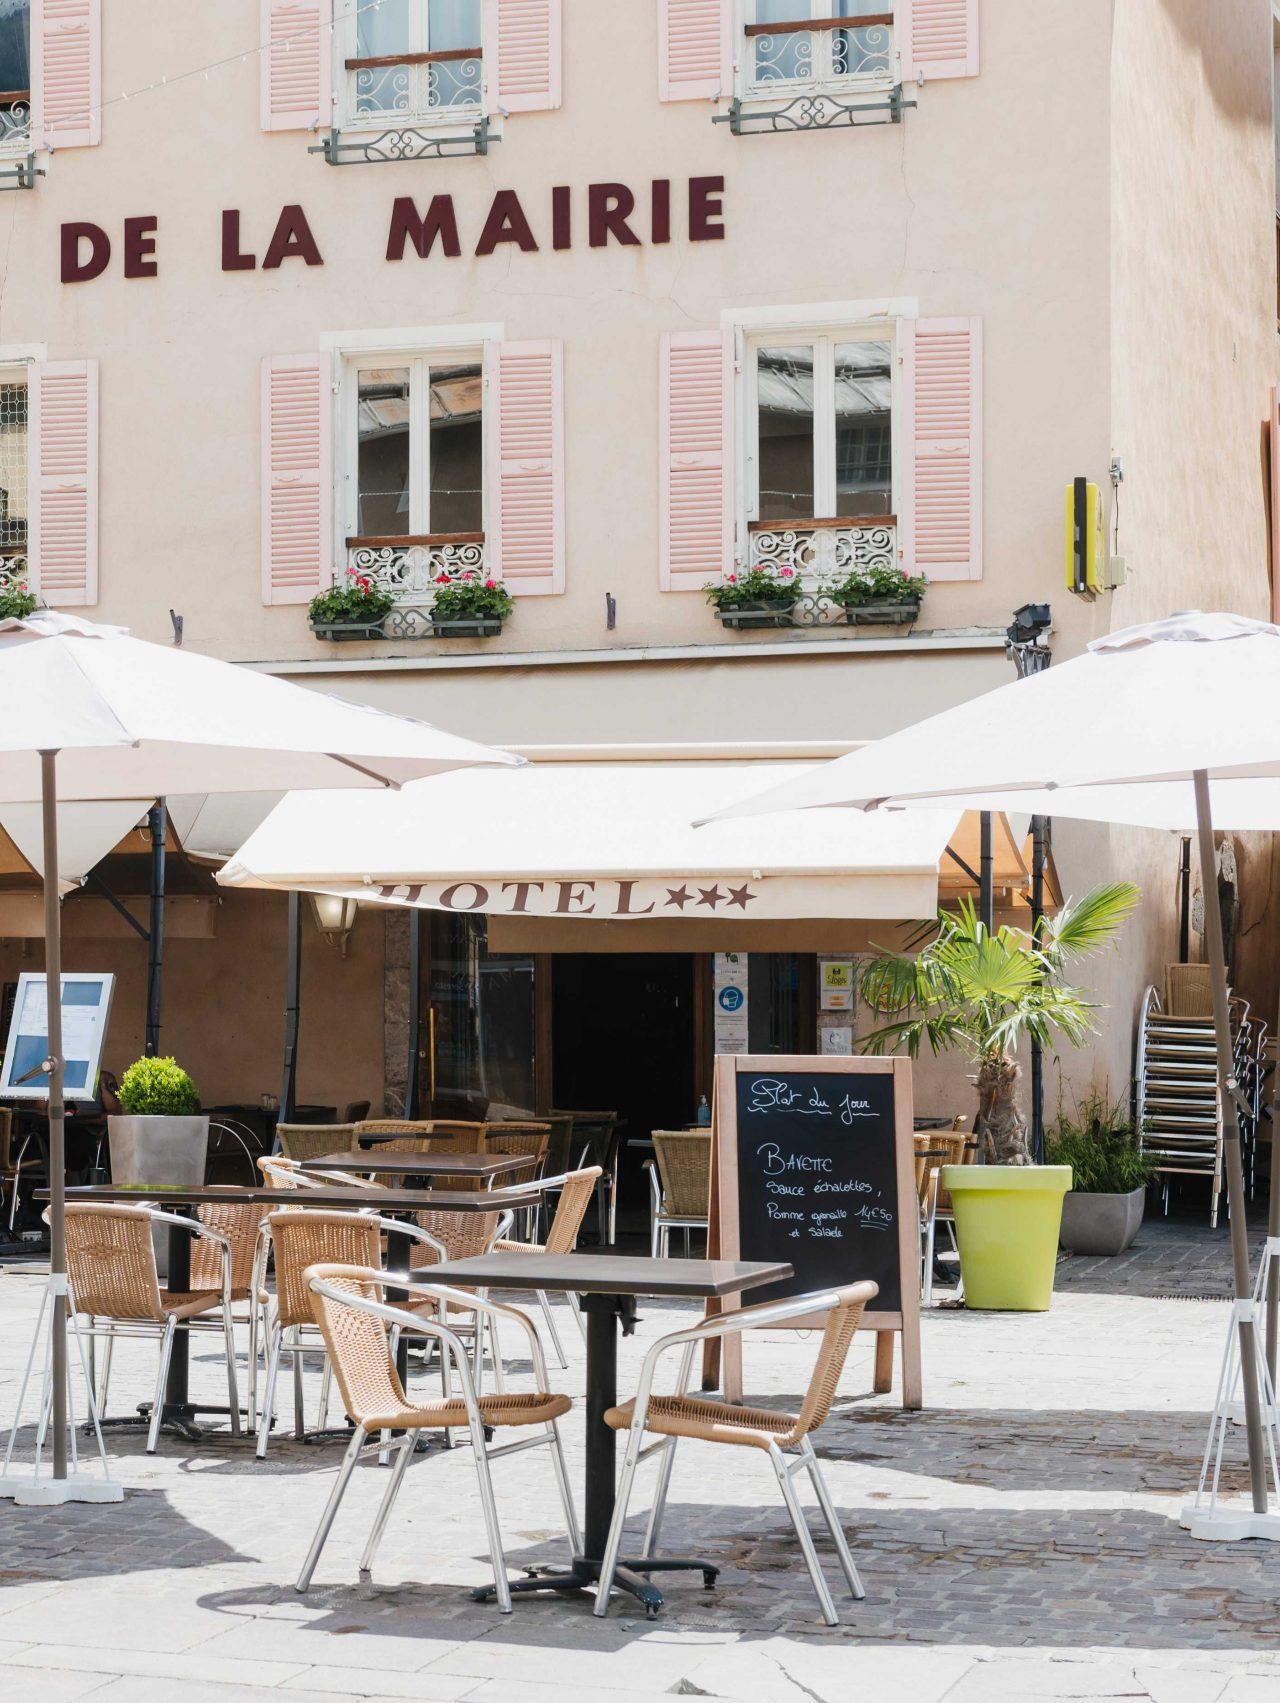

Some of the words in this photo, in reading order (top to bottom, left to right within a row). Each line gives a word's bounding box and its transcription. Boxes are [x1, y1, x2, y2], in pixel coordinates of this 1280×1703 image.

[60, 215, 158, 284] DE
[221, 204, 324, 272] LA
[385, 175, 725, 262] MAIRIE
[377, 881, 657, 914] HOTEL
[751, 1078, 802, 1107] Plat
[809, 1087, 830, 1108] du
